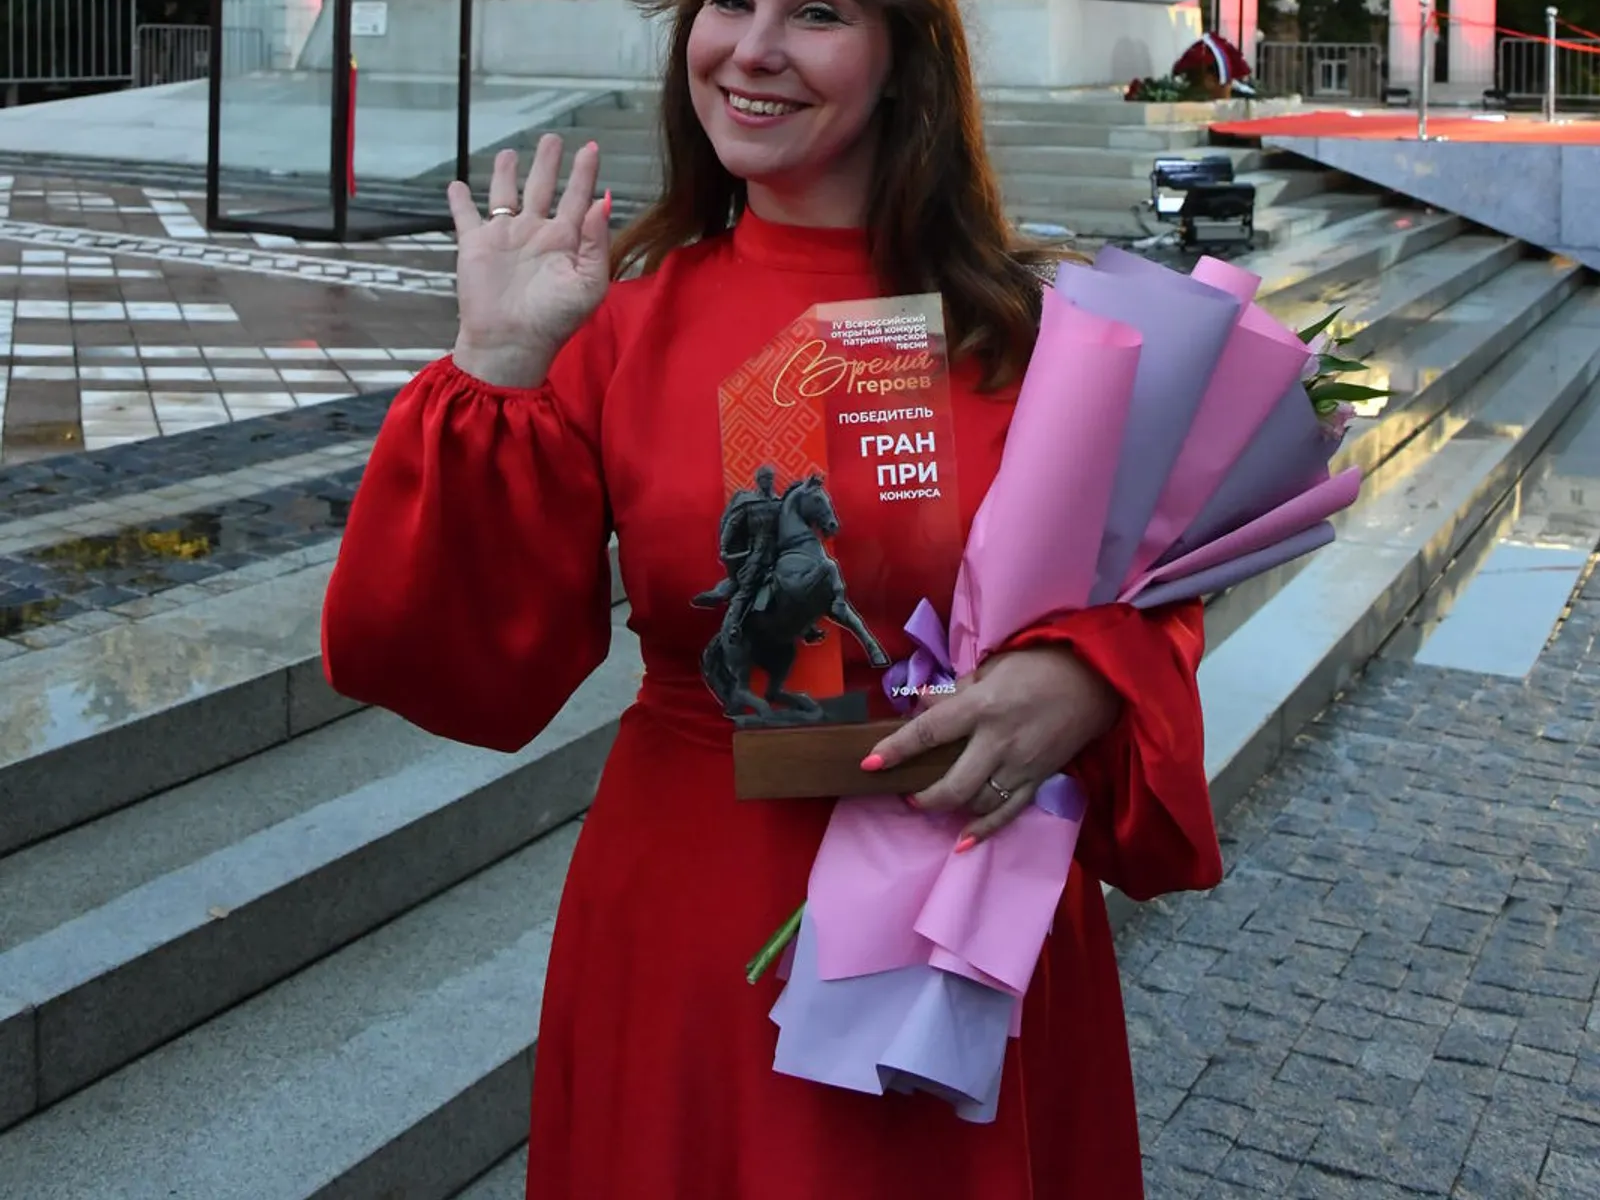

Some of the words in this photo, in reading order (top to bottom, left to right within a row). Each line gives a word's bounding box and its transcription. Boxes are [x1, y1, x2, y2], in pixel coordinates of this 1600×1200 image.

[832, 321, 842, 330] IV
[844, 313, 926, 329] Всероссийский
[831, 326, 882, 339] открытый
[884, 323, 928, 335] конкурс
[843, 332, 928, 347] патриотической
[896, 341, 928, 350] песни
[773, 339, 934, 407] Время
[856, 376, 932, 396] героев
[838, 407, 934, 424] ПОБЕДИТЕЛЬ
[860, 431, 935, 457] ГРАН
[876, 461, 938, 487] ПРИ
[879, 488, 941, 501] КОНКУРСА
[891, 686, 919, 696] УФА
[929, 684, 956, 695] 2025
